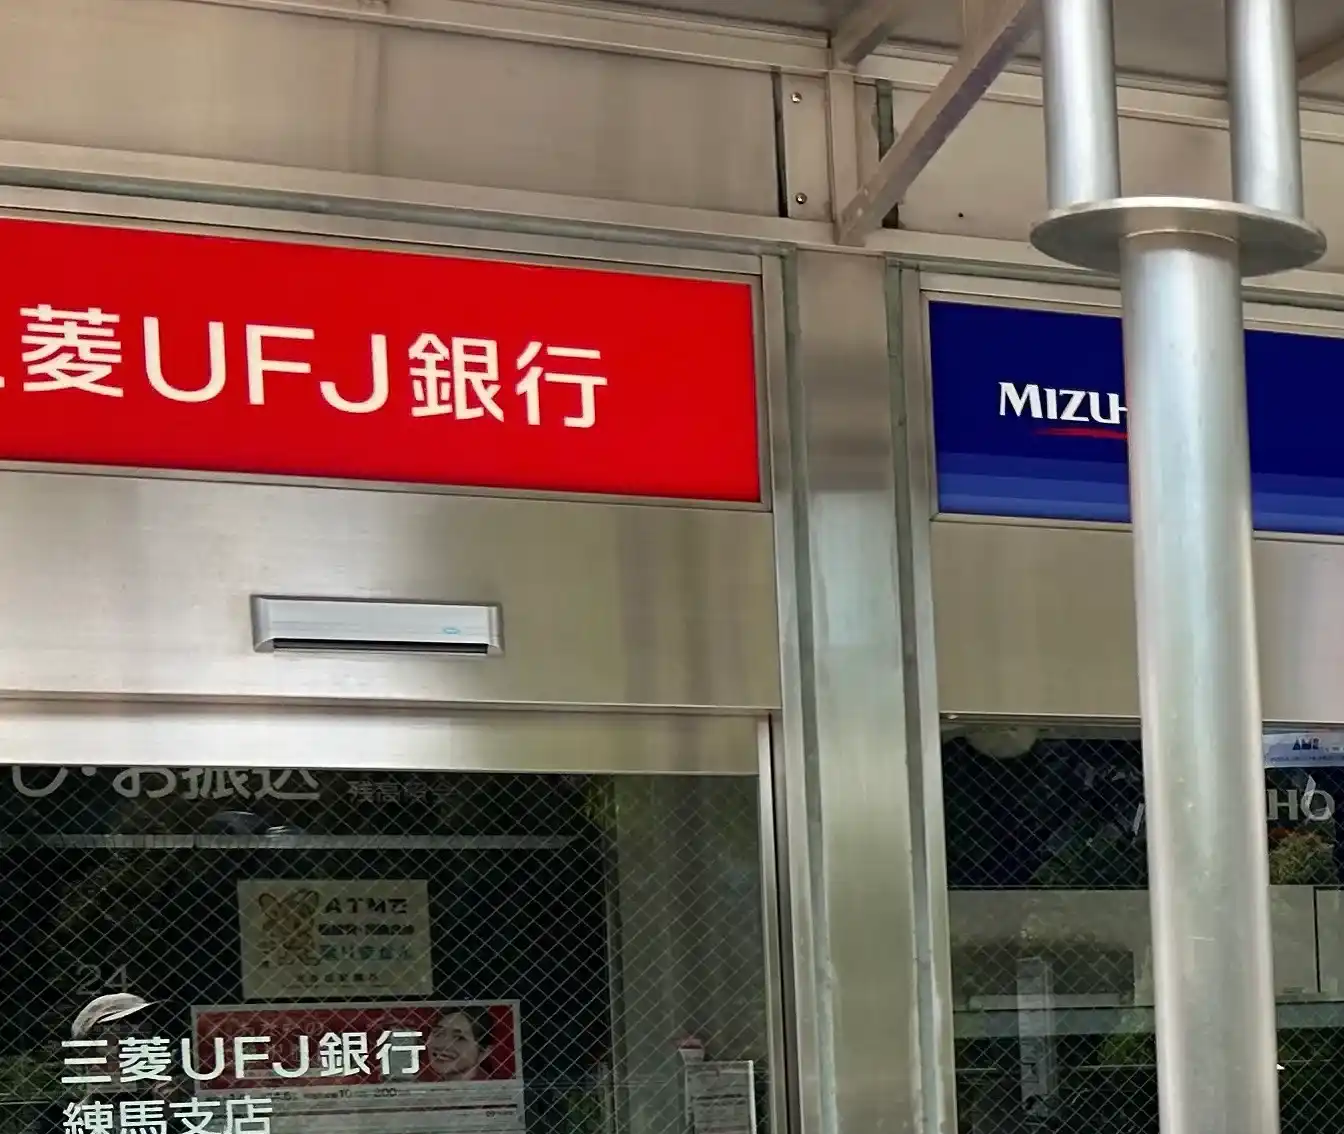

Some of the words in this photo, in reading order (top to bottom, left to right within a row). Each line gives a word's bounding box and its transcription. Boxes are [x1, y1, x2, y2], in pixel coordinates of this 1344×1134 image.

[0, 303, 608, 429] 菱UFJ銀行
[60, 1029, 427, 1085] 三菱UFJ銀行
